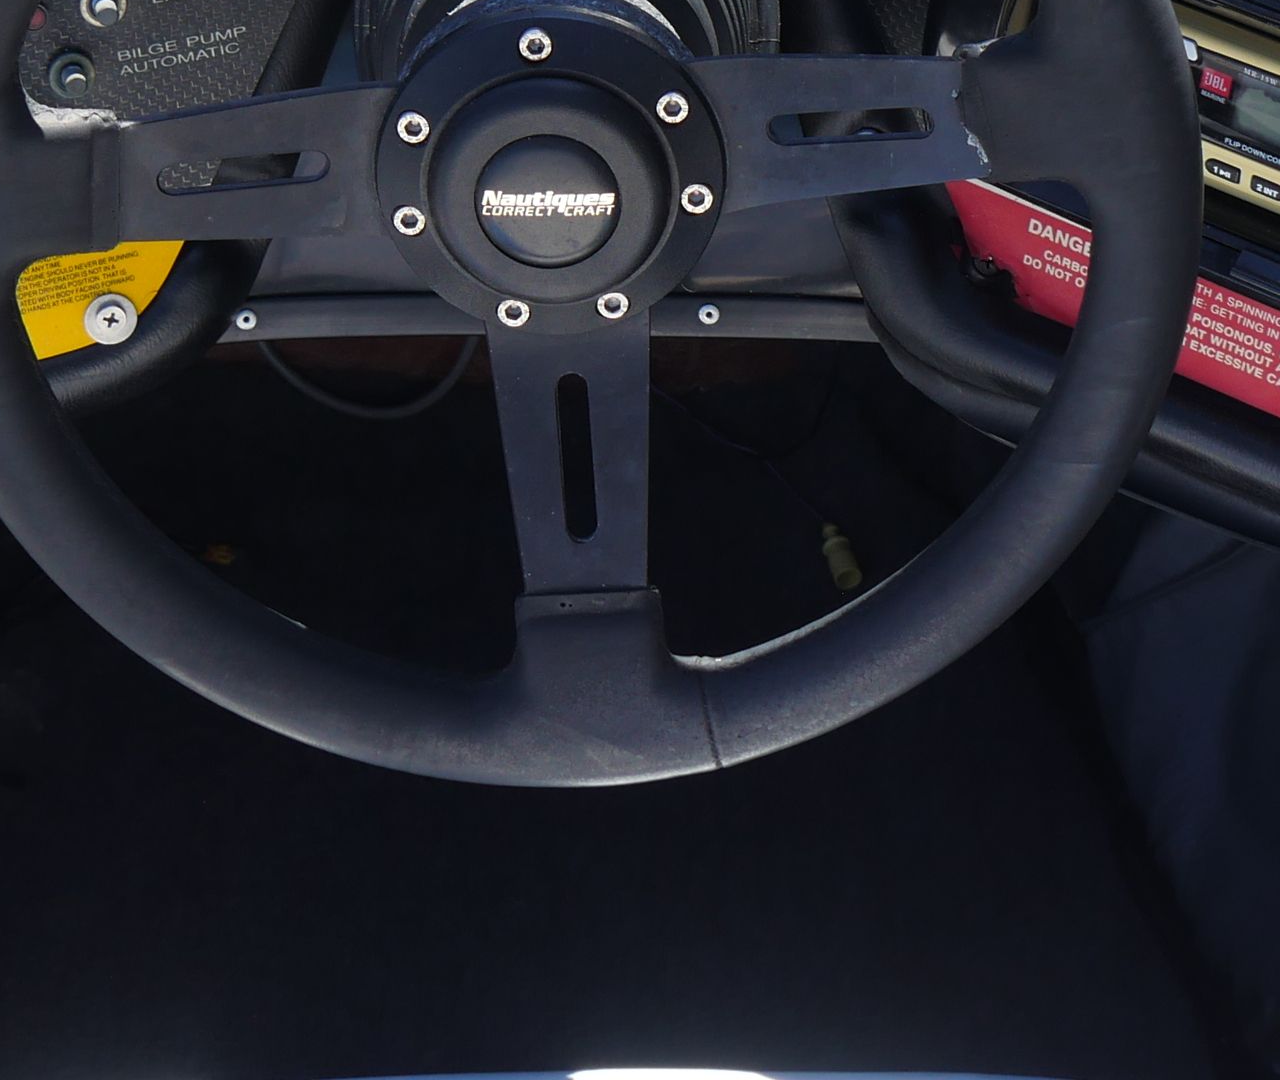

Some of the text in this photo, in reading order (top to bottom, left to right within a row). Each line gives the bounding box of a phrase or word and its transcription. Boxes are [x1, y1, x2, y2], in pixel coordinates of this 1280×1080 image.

[117, 27, 247, 62] BILGE PUMP
[121, 43, 240, 75] AUTOMATIC
[1204, 72, 1228, 91] JBL
[1224, 137, 1241, 147] FLIP
[482, 190, 615, 213] Nautiques
[1256, 184, 1279, 198] 2 INT
[482, 205, 615, 216] CORRECT CRAFT
[1028, 218, 1091, 257] DANGE
[1023, 255, 1072, 282] DO NOT
[1044, 250, 1088, 275] CARBO
[1213, 292, 1224, 303] A
[1191, 312, 1275, 356] POISONOUS.
[1209, 304, 1265, 334] GETTING
[1265, 327, 1280, 340] IN
[1188, 339, 1264, 379] EXCESSIVE
[1209, 333, 1274, 368] WITHOUT
